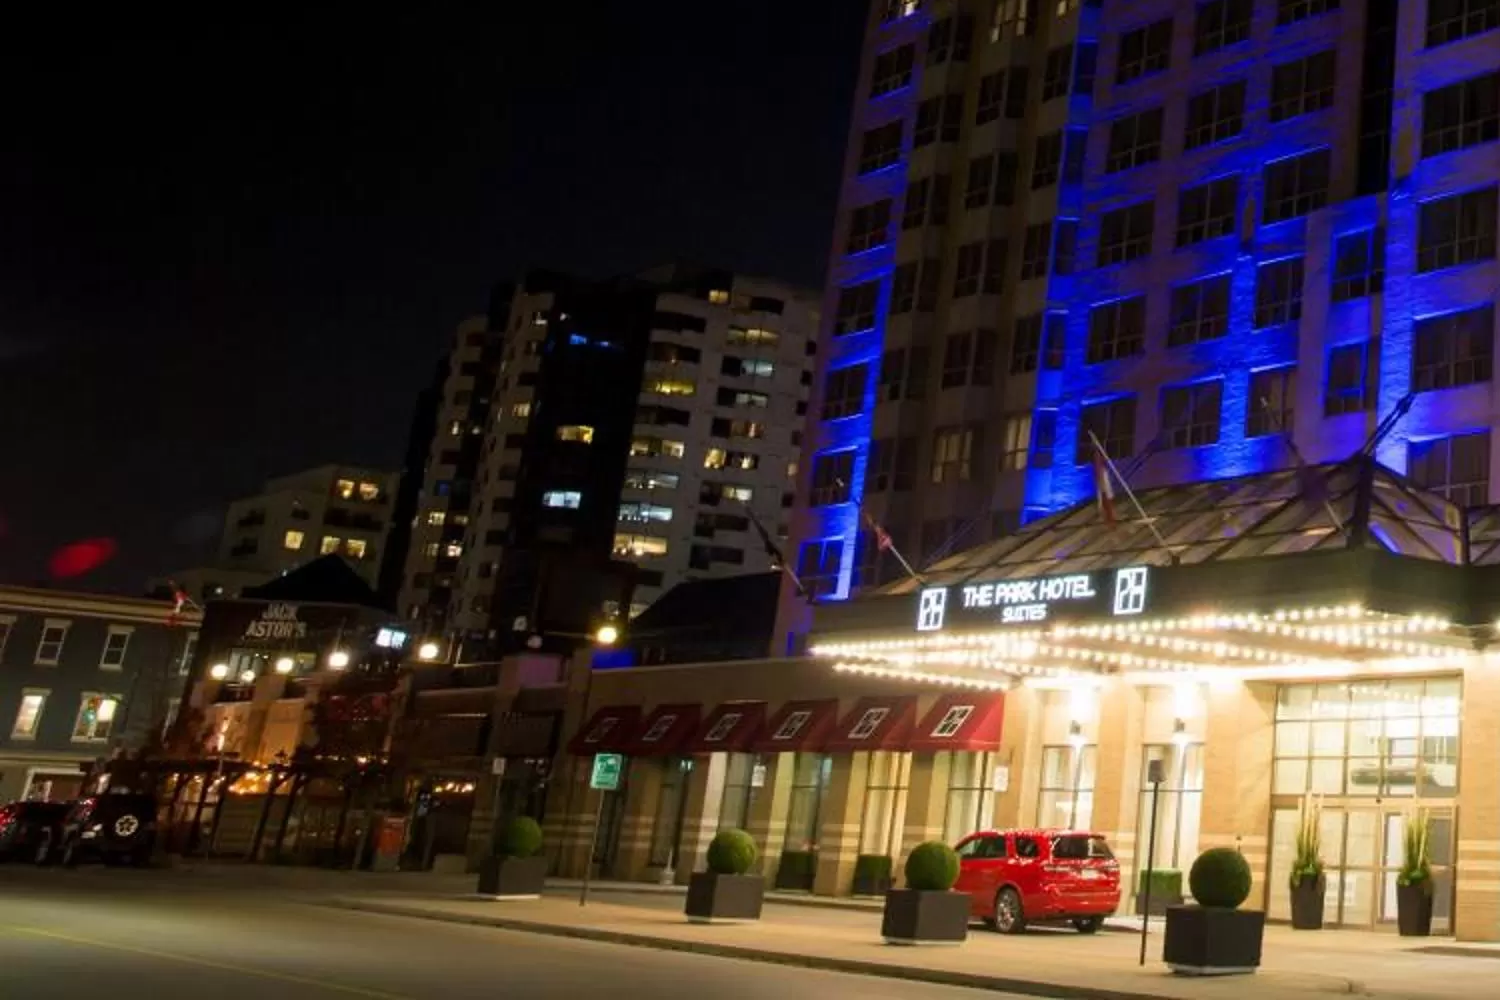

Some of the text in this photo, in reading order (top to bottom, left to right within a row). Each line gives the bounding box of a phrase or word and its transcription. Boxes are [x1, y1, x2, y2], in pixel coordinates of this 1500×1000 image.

[963, 575, 1096, 608] THE PARK HOTEL
[1001, 603, 1047, 623] SUITES
